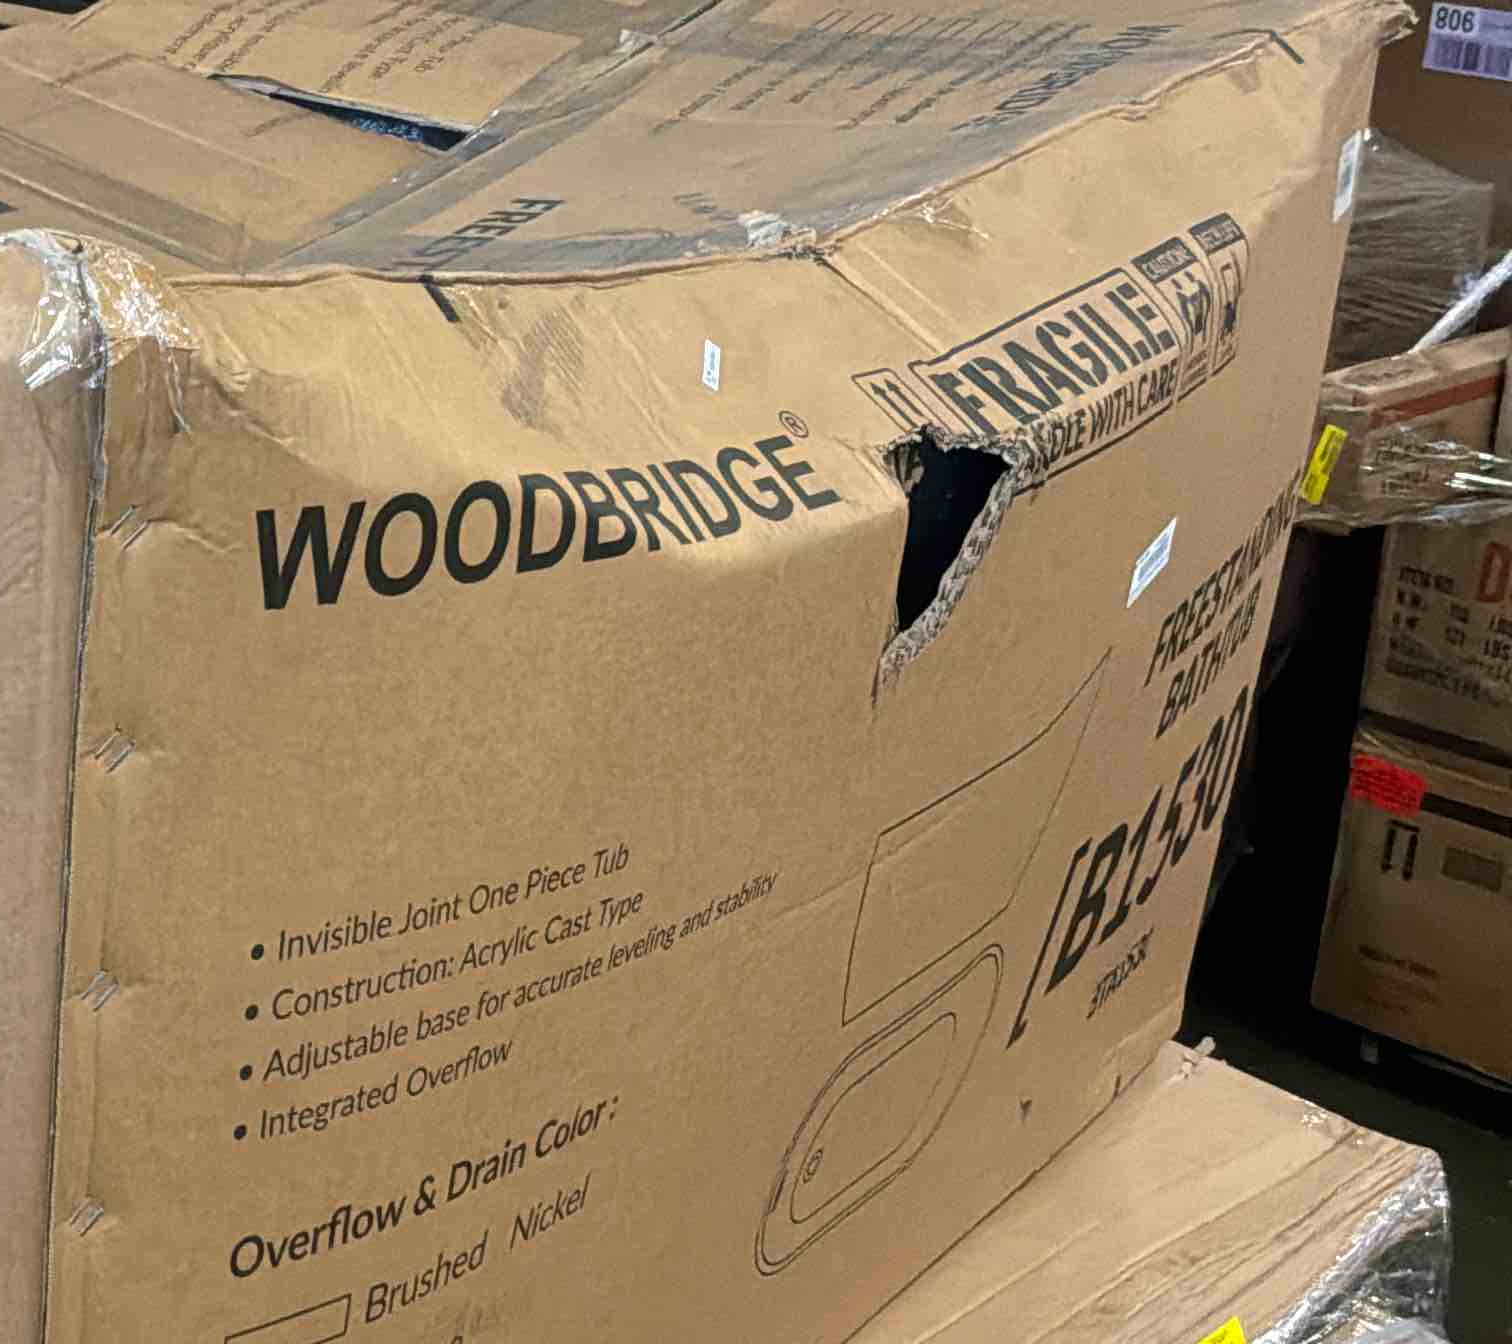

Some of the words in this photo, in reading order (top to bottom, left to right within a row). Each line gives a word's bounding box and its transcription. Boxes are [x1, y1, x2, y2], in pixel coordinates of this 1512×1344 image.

[1434, 5, 1476, 34] 806
[928, 281, 1178, 437] FRAGILE
[272, 956, 456, 1023] Construction:
[460, 928, 536, 975] Acrylic
[542, 909, 593, 946] Cast
[598, 887, 644, 933] Type
[276, 909, 392, 962] Invisible
[397, 894, 462, 937] Joint
[468, 881, 519, 915] One
[524, 860, 586, 900] Piece
[593, 842, 629, 880] Tub
[263, 1016, 409, 1084] Adjustable
[415, 999, 470, 1040] base
[475, 986, 511, 1024] for
[512, 957, 603, 1008] accurate
[607, 919, 677, 971] leveling
[678, 906, 712, 942] and
[713, 870, 780, 927] stability
[258, 1077, 398, 1142] Integrated
[405, 1037, 514, 1098] Overflow
[229, 1193, 407, 1279] Overflow
[411, 1174, 439, 1218] &
[445, 1139, 527, 1204] Drain
[534, 1094, 621, 1160] Color:
[363, 1231, 489, 1324] Brushed
[509, 1174, 592, 1250] Nickel
